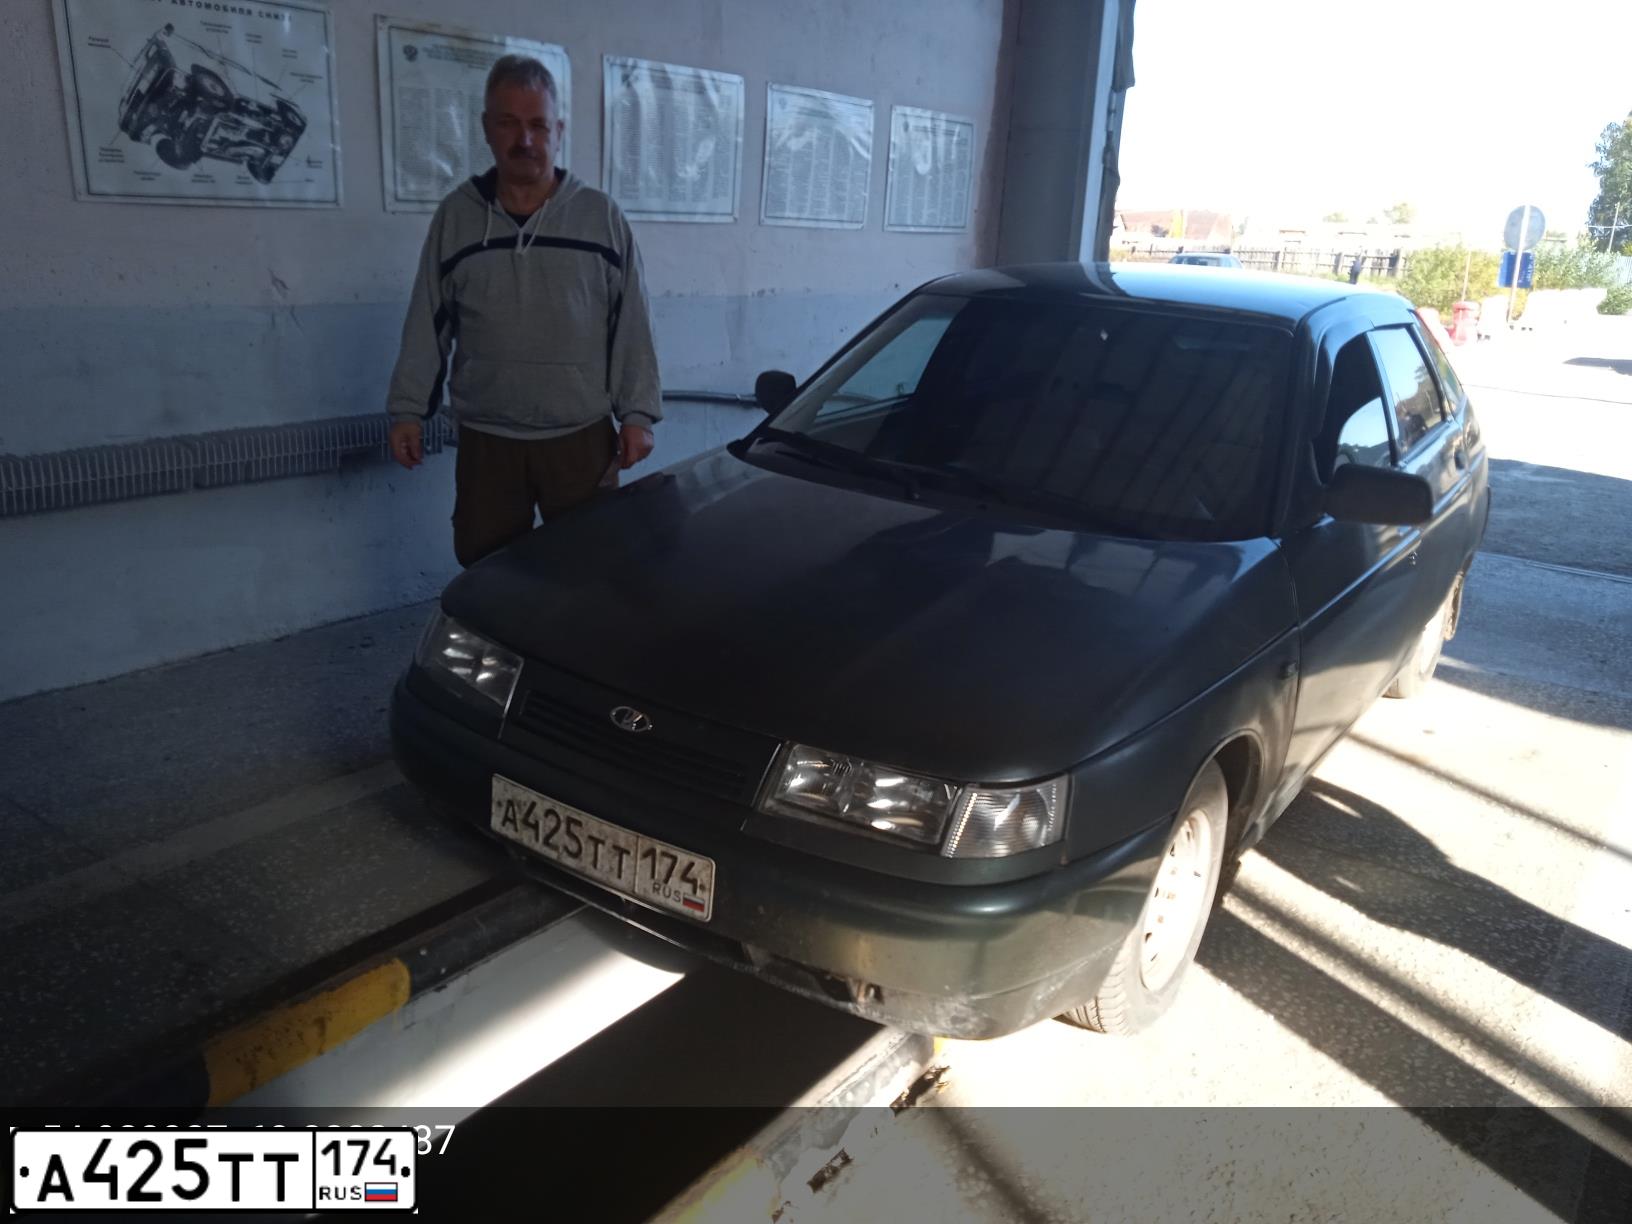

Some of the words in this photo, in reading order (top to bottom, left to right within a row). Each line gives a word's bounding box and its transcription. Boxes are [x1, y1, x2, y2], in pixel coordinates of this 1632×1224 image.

[502, 800, 630, 879] А425ТТ
[642, 848, 698, 894] 174
[653, 882, 681, 902] RUS
